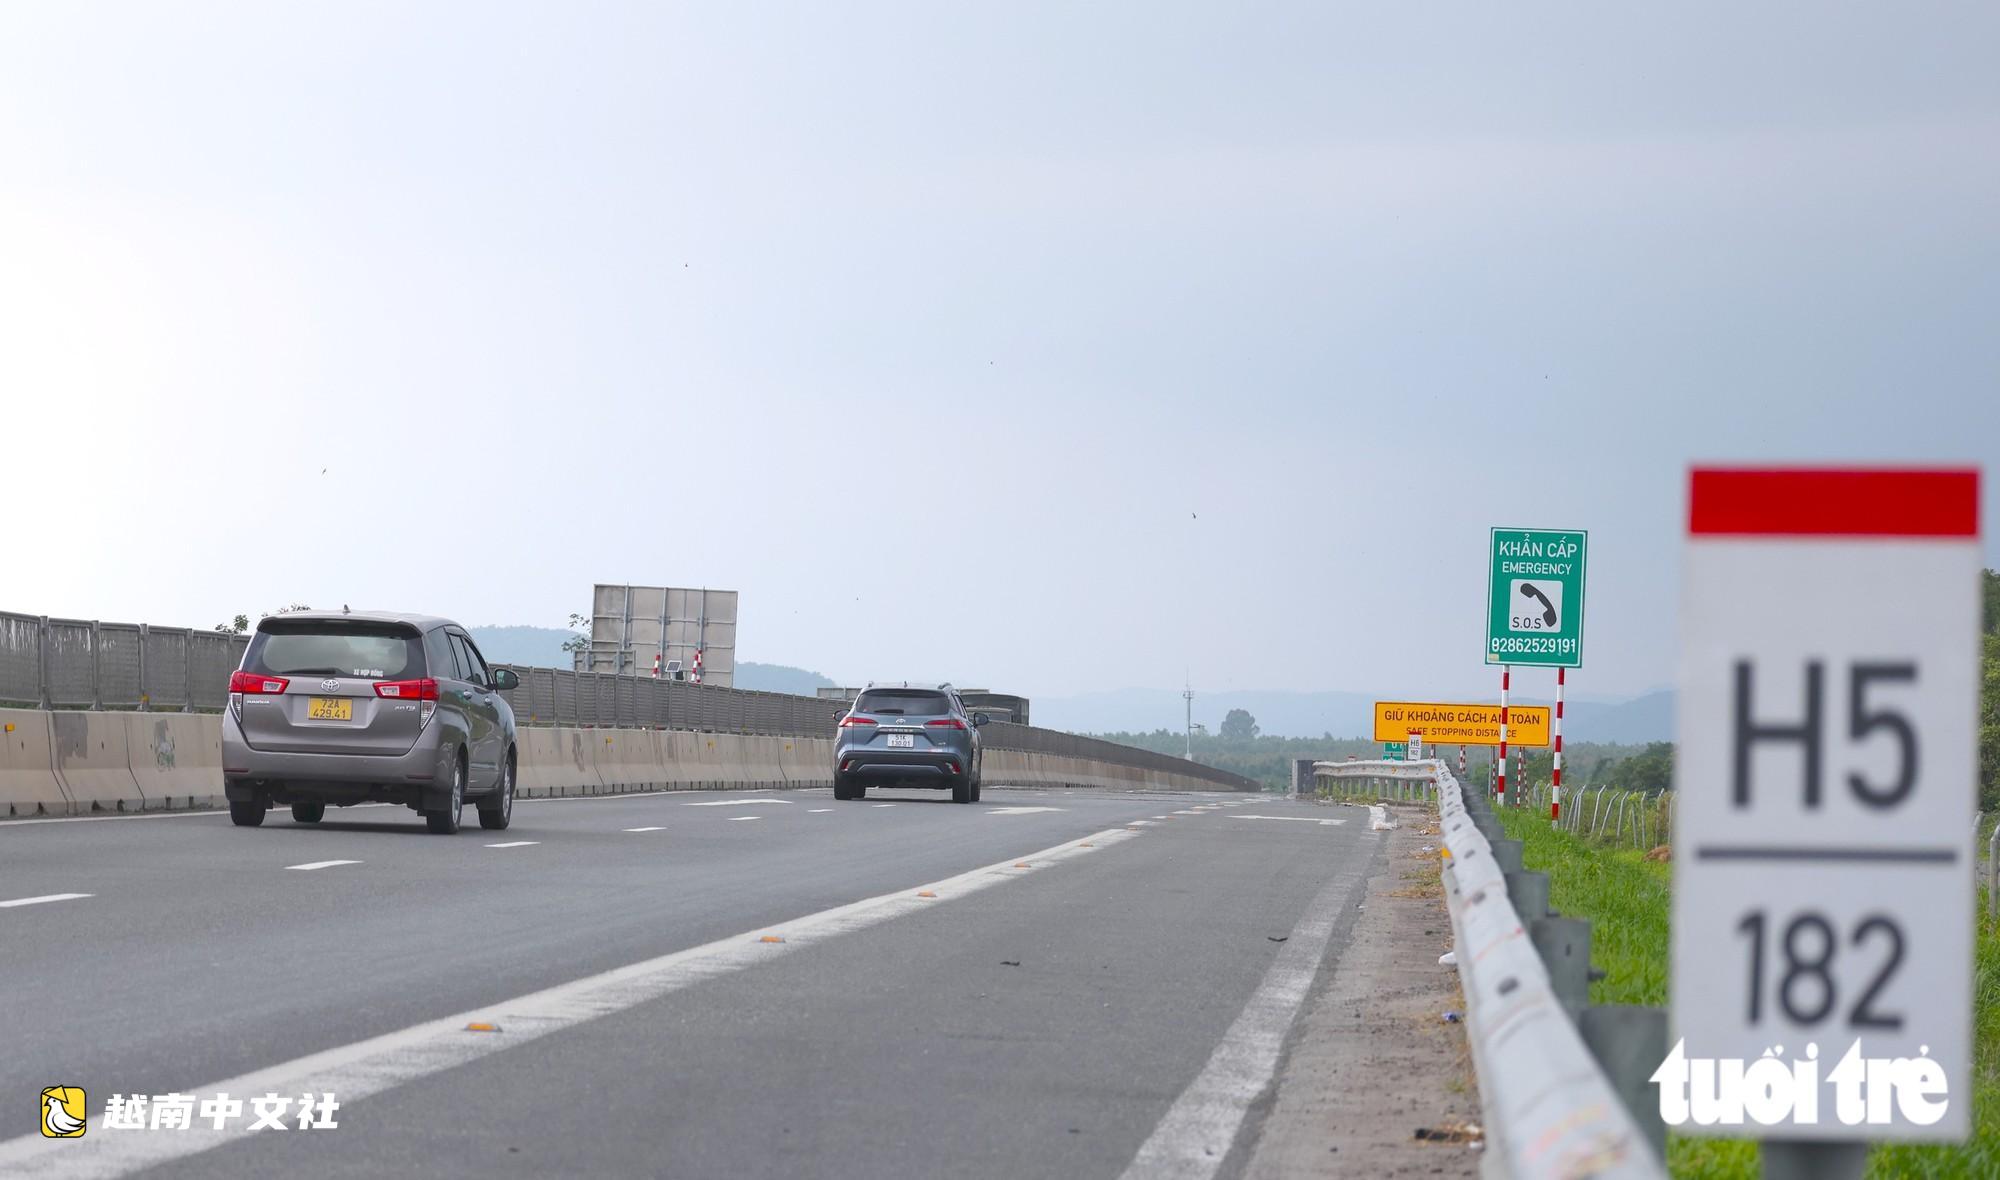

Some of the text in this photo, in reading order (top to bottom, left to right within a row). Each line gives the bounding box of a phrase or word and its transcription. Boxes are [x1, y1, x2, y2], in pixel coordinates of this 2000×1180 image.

[1499, 533, 1578, 558] KHẨN CẤP
[1502, 561, 1572, 575] EMERGENCY
[1512, 616, 1542, 629] S.O.S
[322, 699, 340, 709] 72A
[313, 708, 347, 719] 429.41
[1384, 708, 1404, 721] GIỮ
[1407, 708, 1454, 723] KHOẢNG
[1457, 710, 1487, 724] CÁCH
[1511, 711, 1540, 725] TOÀN
[1431, 728, 1474, 737] STOPPING
[1475, 729, 1517, 738] DISTACE
[1730, 657, 1922, 812] H5
[1735, 908, 1910, 1033] 182
